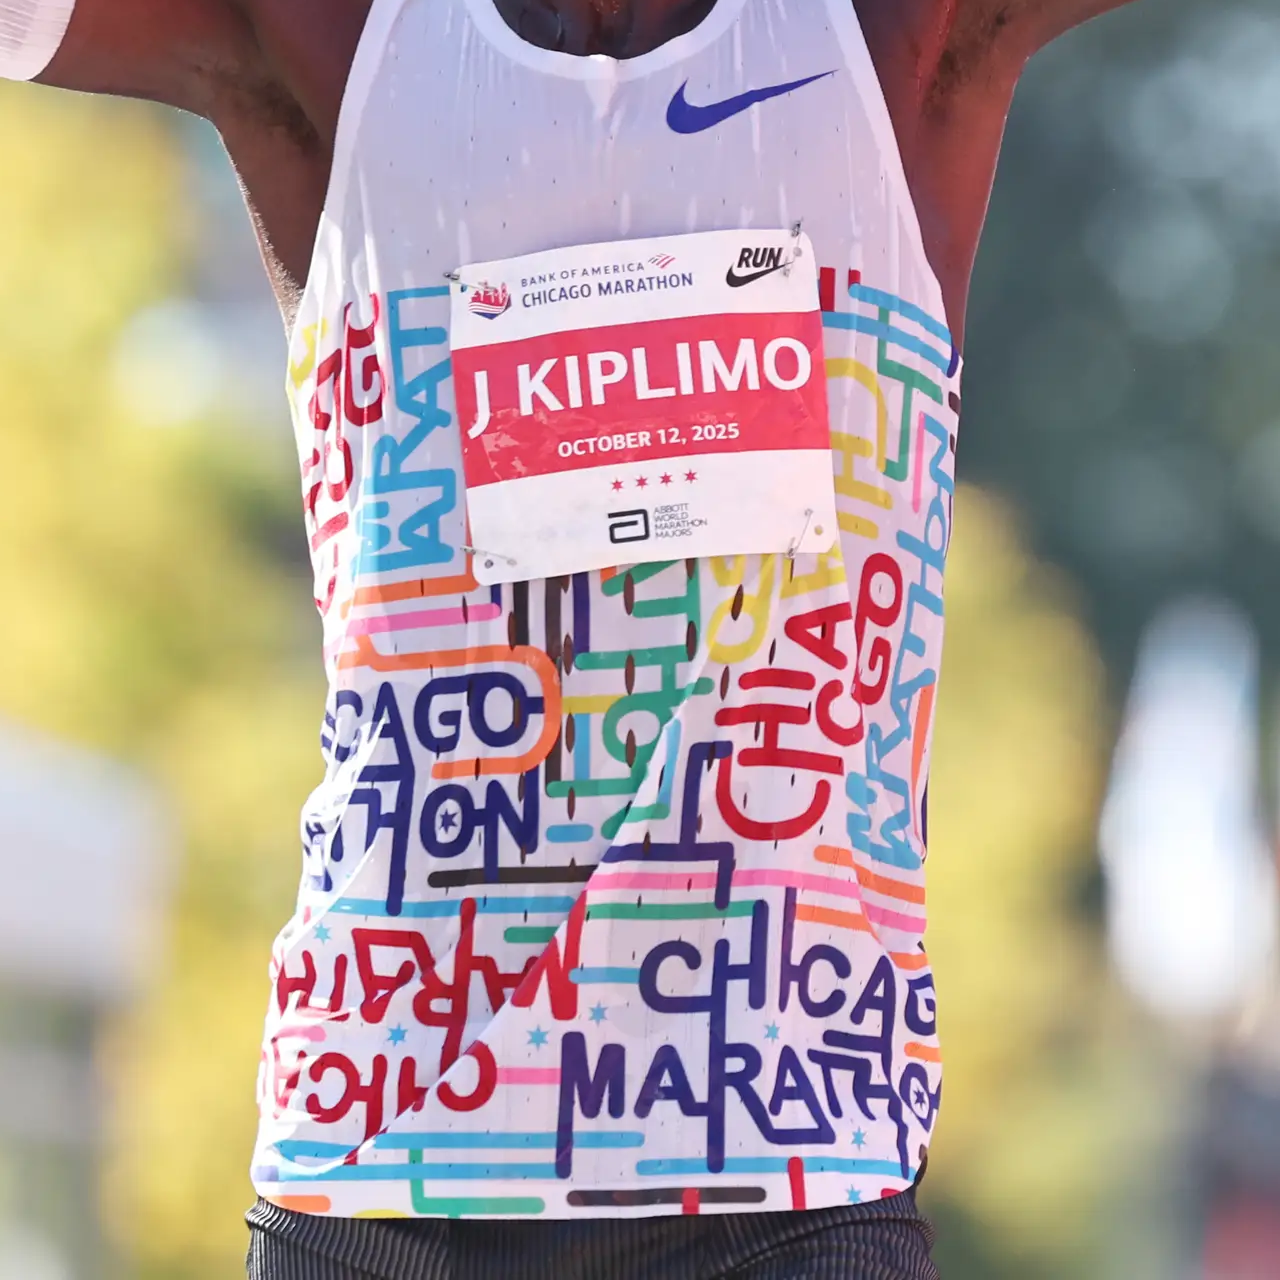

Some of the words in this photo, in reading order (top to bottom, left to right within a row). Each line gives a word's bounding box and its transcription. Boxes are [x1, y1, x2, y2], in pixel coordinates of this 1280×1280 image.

[737, 247, 783, 268] RUN
[521, 272, 556, 287] BANK
[560, 269, 577, 280] OF
[581, 262, 645, 277] AMERICA
[522, 283, 592, 308] CHICAGO
[598, 272, 693, 296] MARATHON
[467, 370, 491, 439] J
[517, 337, 812, 417] KIPLIMO
[558, 430, 651, 458] OCTOBER
[656, 426, 687, 446] 12,
[691, 422, 740, 442] 2025
[654, 503, 689, 513] ABBOTT
[655, 519, 707, 530] MARATHON
[655, 529, 693, 539] MAJORS
